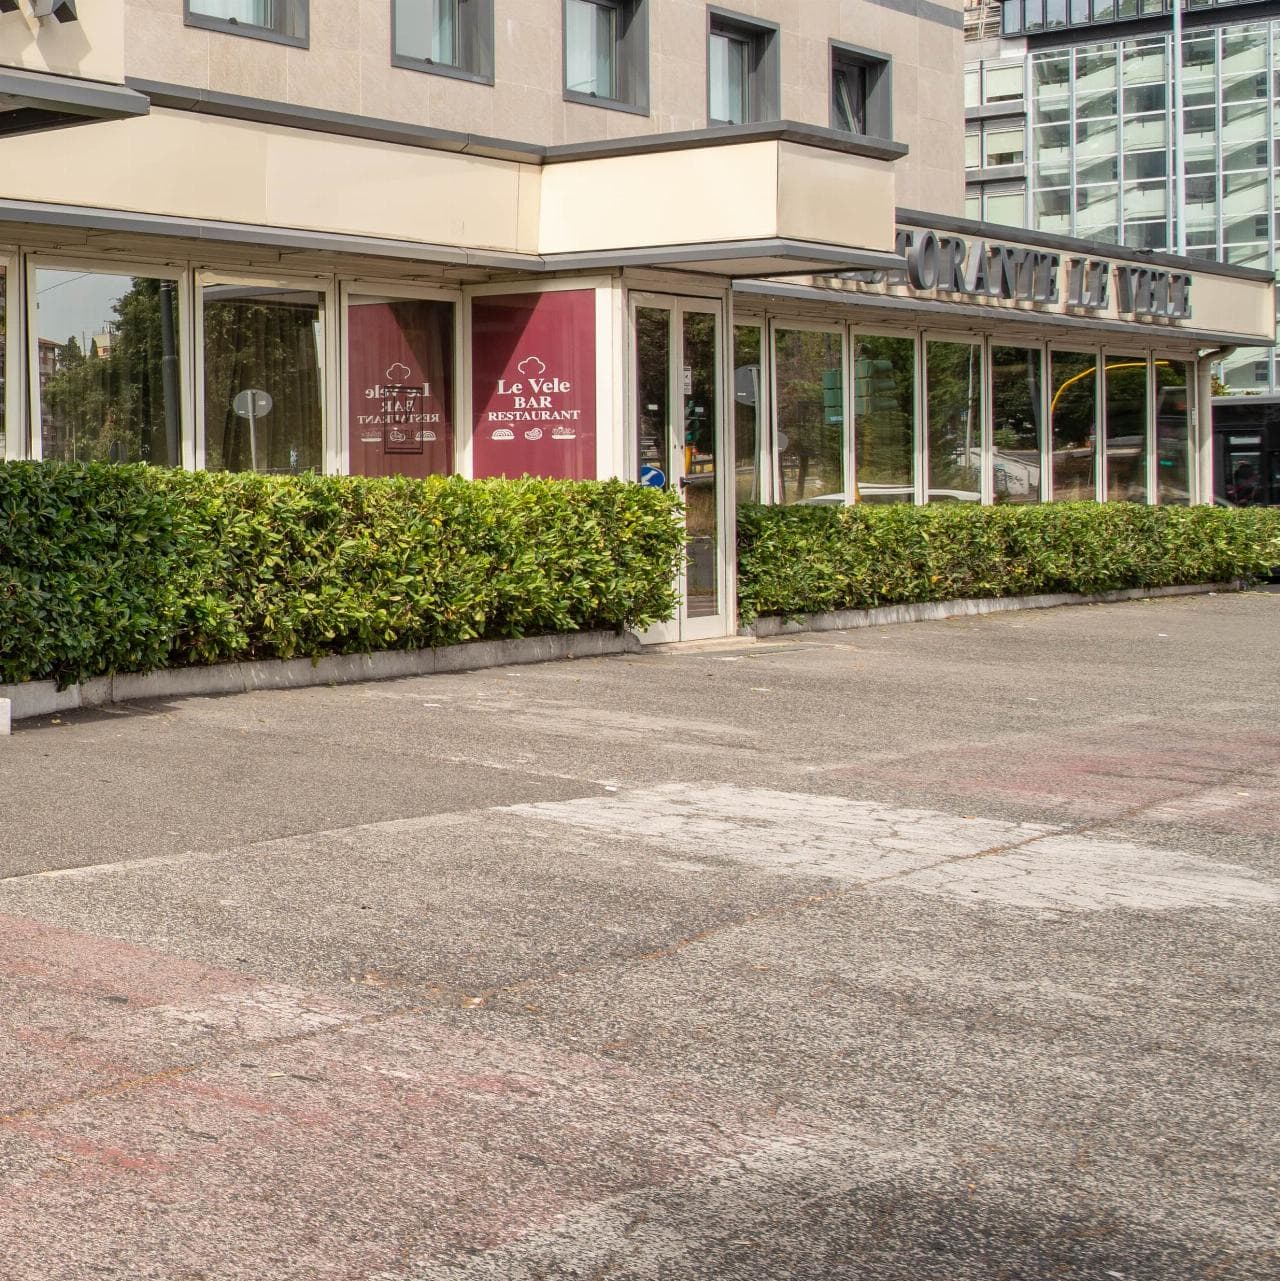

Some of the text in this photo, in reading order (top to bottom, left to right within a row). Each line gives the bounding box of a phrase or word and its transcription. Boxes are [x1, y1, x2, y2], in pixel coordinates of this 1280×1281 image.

[812, 229, 1192, 320] TORANTE LE VELE
[497, 377, 571, 395] Le Vele
[514, 396, 552, 409] BAR
[488, 410, 581, 421] RESTAURANT
